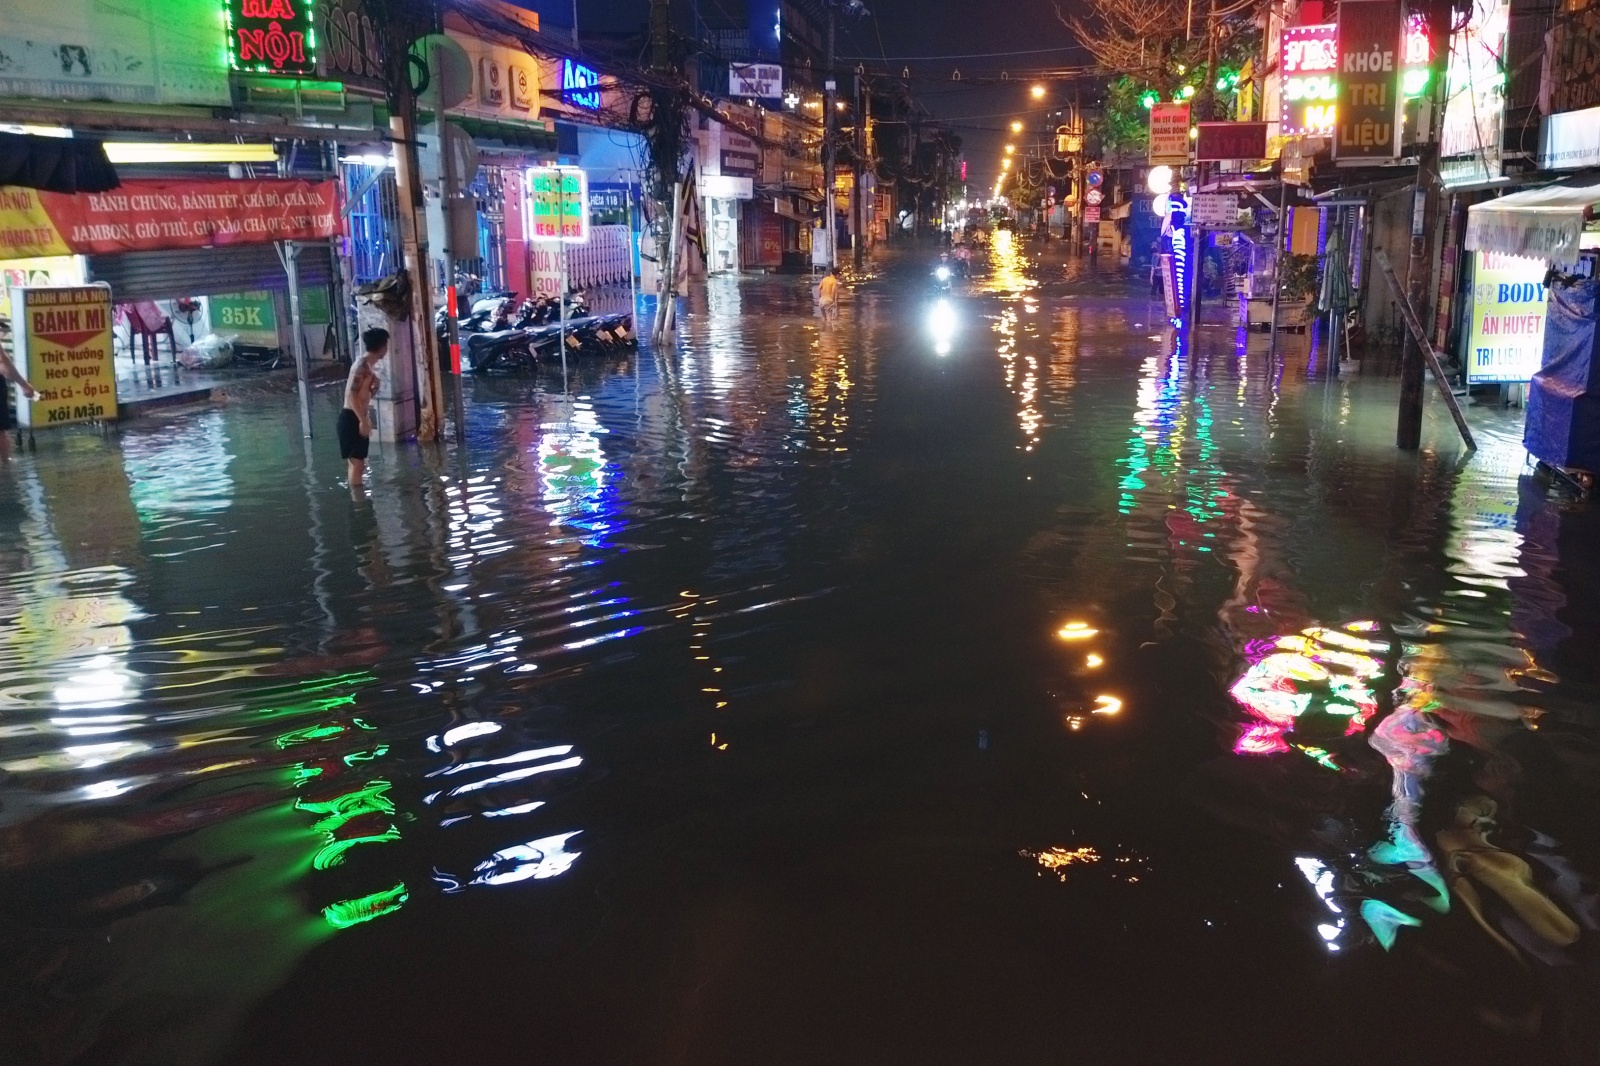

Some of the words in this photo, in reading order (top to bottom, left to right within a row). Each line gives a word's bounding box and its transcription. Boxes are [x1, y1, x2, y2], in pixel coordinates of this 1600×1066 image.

[237, 21, 305, 68] NỘI
[1343, 43, 1393, 73] KHỎE
[1348, 83, 1386, 112] TRỊ
[1341, 118, 1390, 152] LIỆU
[88, 192, 129, 212] BÁNH
[183, 190, 216, 210] BÁNH
[606, 195, 618, 206] 118
[72, 222, 135, 243] JAMBON,
[135, 218, 160, 238] GIÒ
[535, 223, 545, 236] XE
[546, 223, 555, 236] GA
[530, 243, 551, 272] RỬA
[554, 252, 567, 272] XE
[536, 277, 561, 292] 30K
[1497, 283, 1545, 303] BODY
[32, 308, 80, 333] BÁNH
[86, 305, 106, 330] MÌ
[222, 306, 262, 326] 35K
[1481, 310, 1500, 335] ẤN
[1503, 311, 1541, 339] HUYỆT
[40, 352, 65, 365] Thịt
[67, 347, 104, 365] Nướng
[1476, 347, 1494, 370] TRỊ
[45, 368, 68, 380] Heo
[71, 366, 100, 379] Quay
[60, 385, 74, 398] Cá
[83, 379, 97, 397] Ốp
[99, 384, 110, 394] La
[48, 406, 70, 422] Xôi
[74, 403, 104, 421] Mặn
